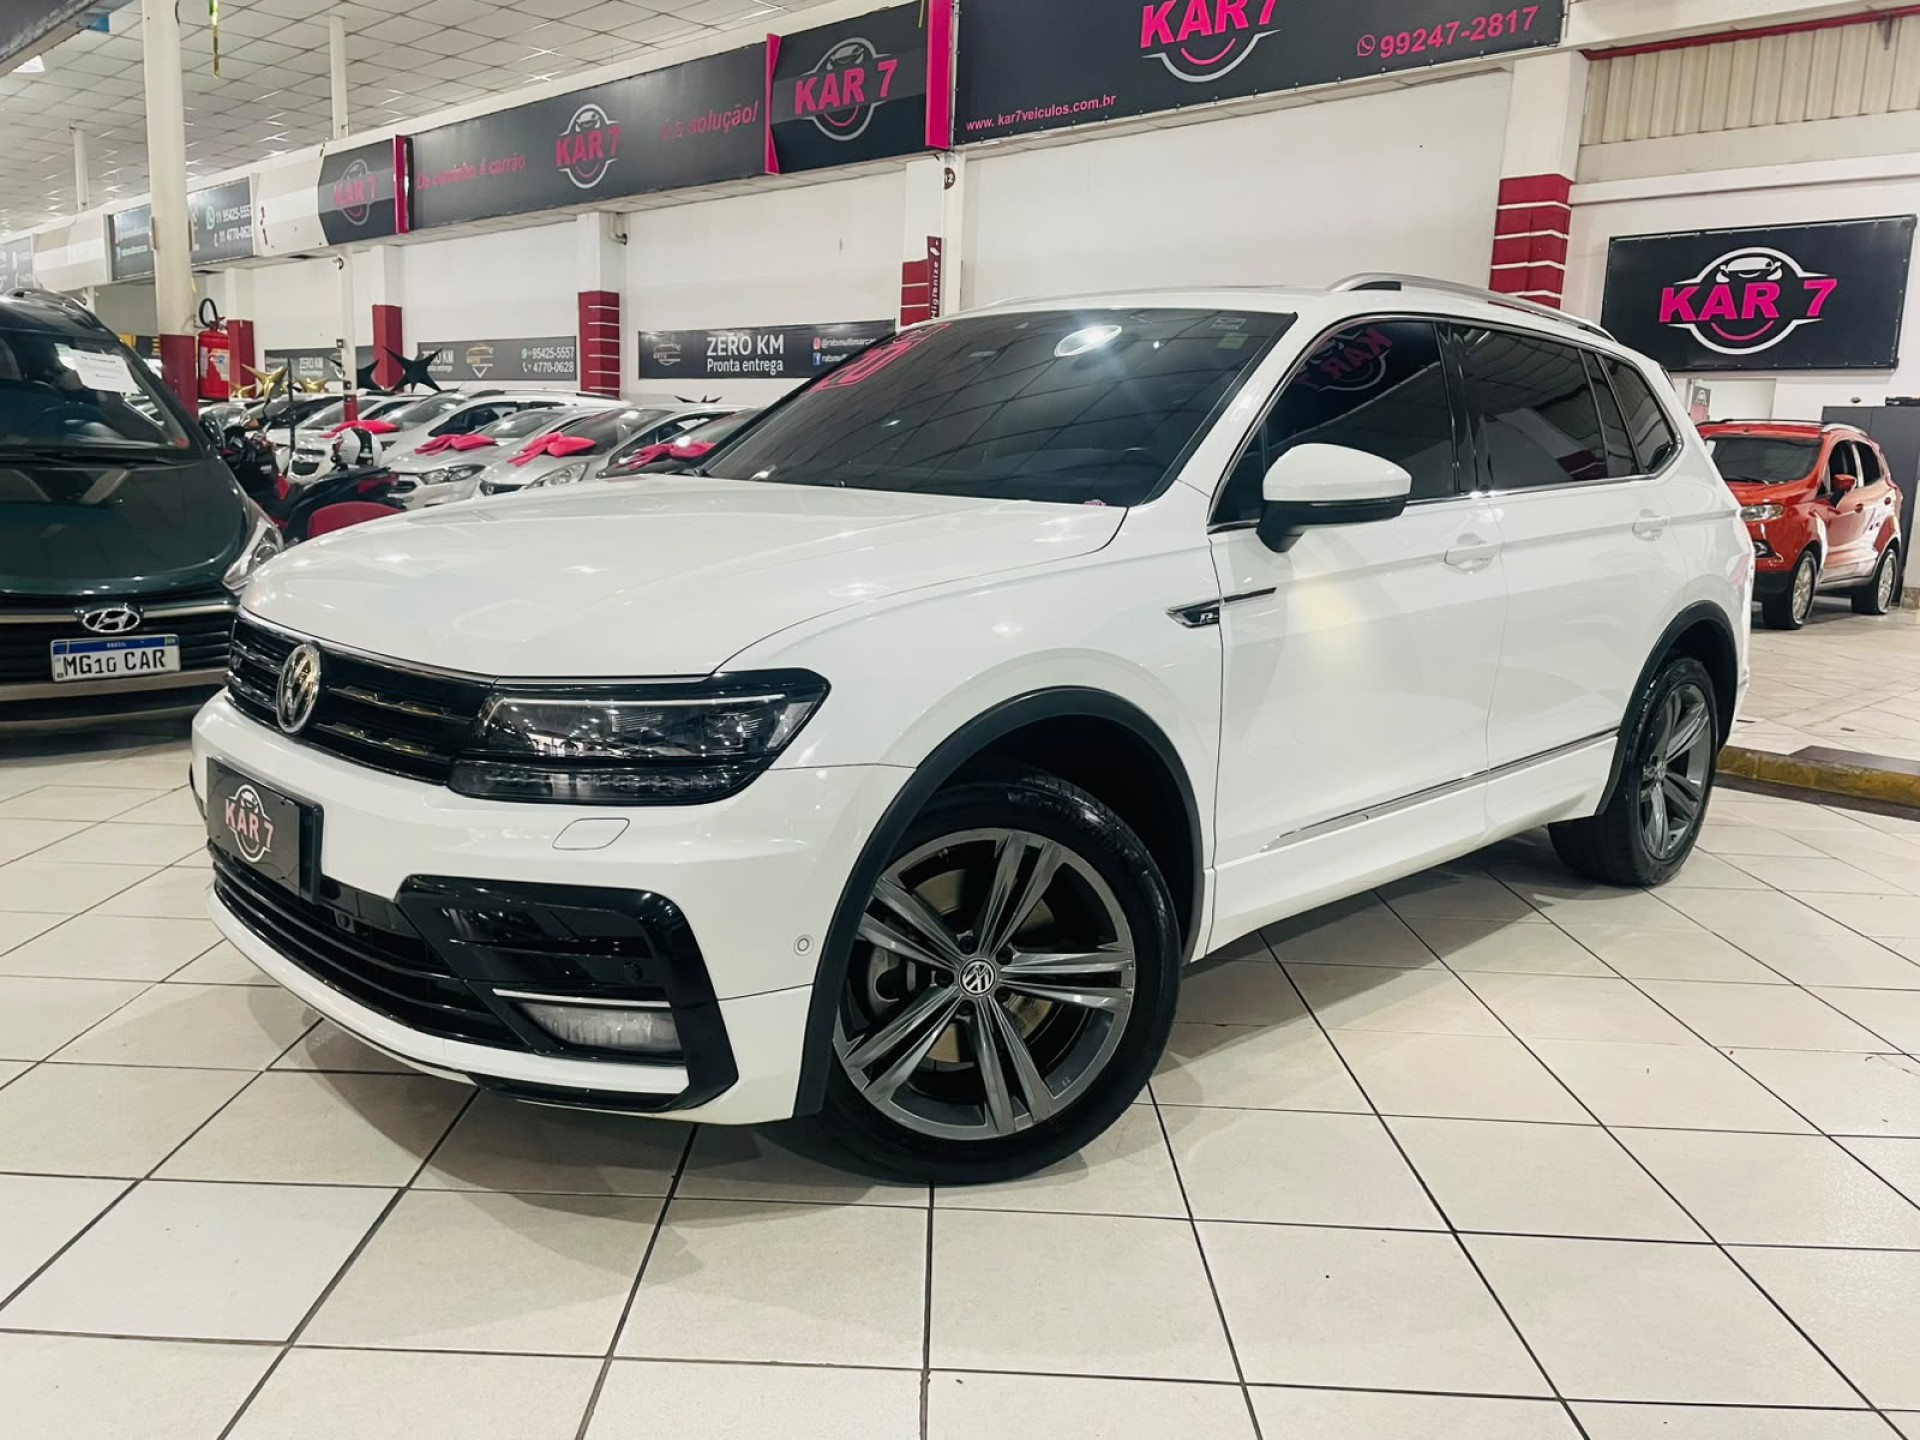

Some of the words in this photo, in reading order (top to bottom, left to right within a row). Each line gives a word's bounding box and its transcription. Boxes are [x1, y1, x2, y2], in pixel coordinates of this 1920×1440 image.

[1140, 0, 1249, 48] KAR
[1379, 6, 1539, 59] 99247-2817
[795, 67, 865, 115] KAR
[877, 58, 898, 98] 7
[965, 119, 995, 132] www.
[997, 94, 1117, 126] kar7veiculos.com.br
[556, 130, 604, 168] KAR
[607, 125, 623, 156] 7
[333, 179, 365, 206] KAR
[367, 176, 377, 200] 7
[1658, 282, 1781, 323] KAR
[1803, 278, 1838, 317] 7
[706, 335, 752, 356] ZERO
[757, 334, 785, 355] KM
[533, 361, 575, 373] 4770-0628
[707, 358, 740, 373] Pronta
[742, 359, 784, 375] entrega
[124, 649, 166, 671] CAR
[225, 799, 260, 843] KAR
[263, 820, 274, 848] 7
